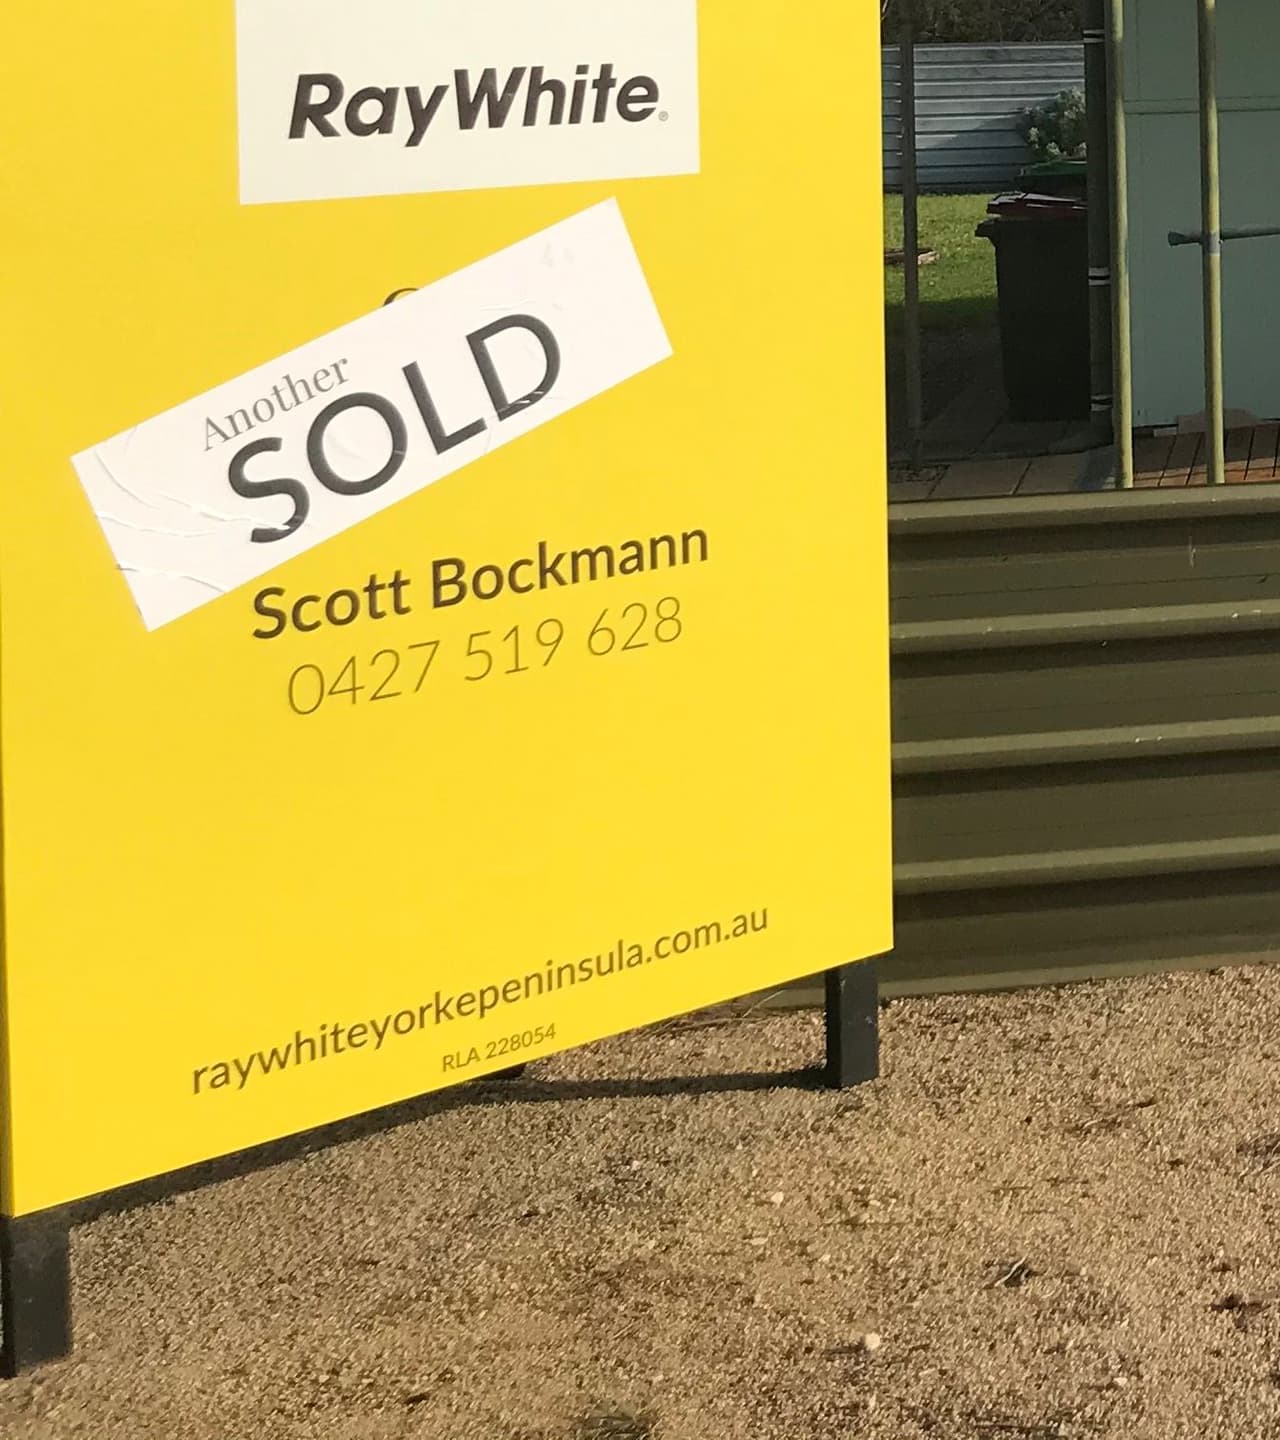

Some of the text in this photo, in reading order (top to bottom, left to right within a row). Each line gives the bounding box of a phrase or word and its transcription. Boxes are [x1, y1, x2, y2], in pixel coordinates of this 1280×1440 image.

[202, 356, 349, 451] Another
[228, 313, 562, 544] SOLD
[252, 528, 708, 640] Scott Bockmann
[287, 596, 683, 716] 0427 519 628
[191, 907, 769, 1094] raywhiteyorkepeninsula.com.au
[442, 1023, 557, 1072] RLA 228054
